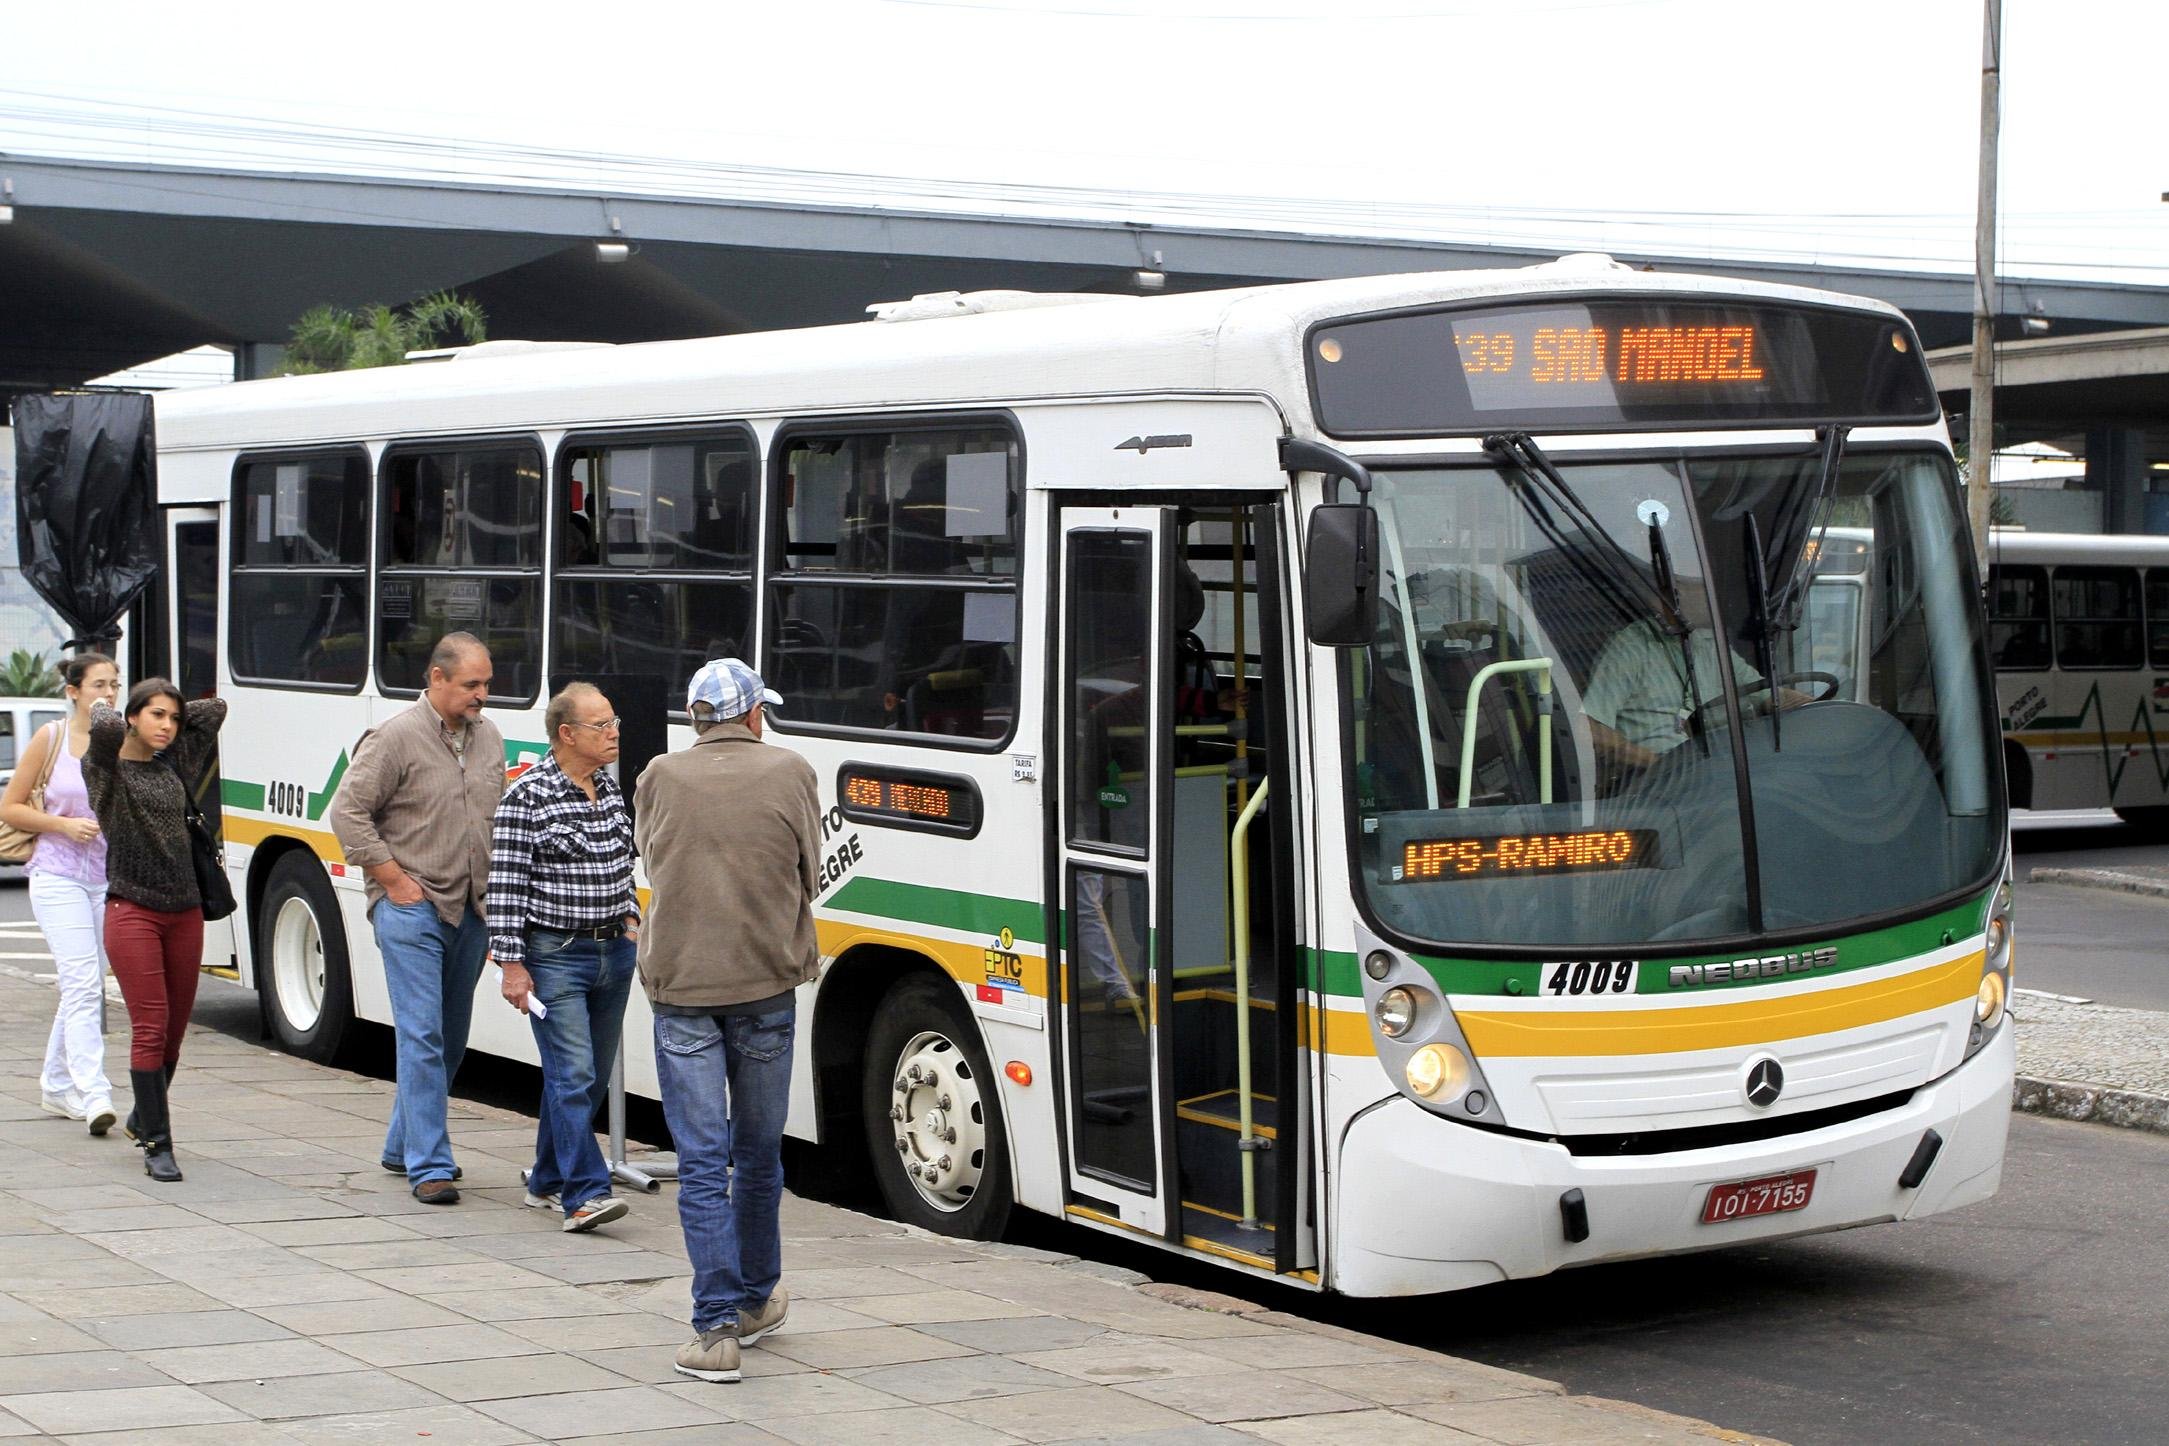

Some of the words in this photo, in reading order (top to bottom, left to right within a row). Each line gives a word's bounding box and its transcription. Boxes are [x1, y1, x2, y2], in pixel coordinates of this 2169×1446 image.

[1454, 335, 1514, 373] 39
[1618, 327, 1763, 381] MANOEL
[268, 780, 304, 818] 4009
[847, 777, 881, 807] 439
[890, 783, 949, 817] MERCADO
[1101, 791, 1127, 803] ENTRADA
[817, 833, 864, 895] EGRE
[1405, 831, 1632, 877] HPS-RAMIRO
[1547, 960, 1634, 996] 4009
[1668, 946, 1839, 987] NEOBUS
